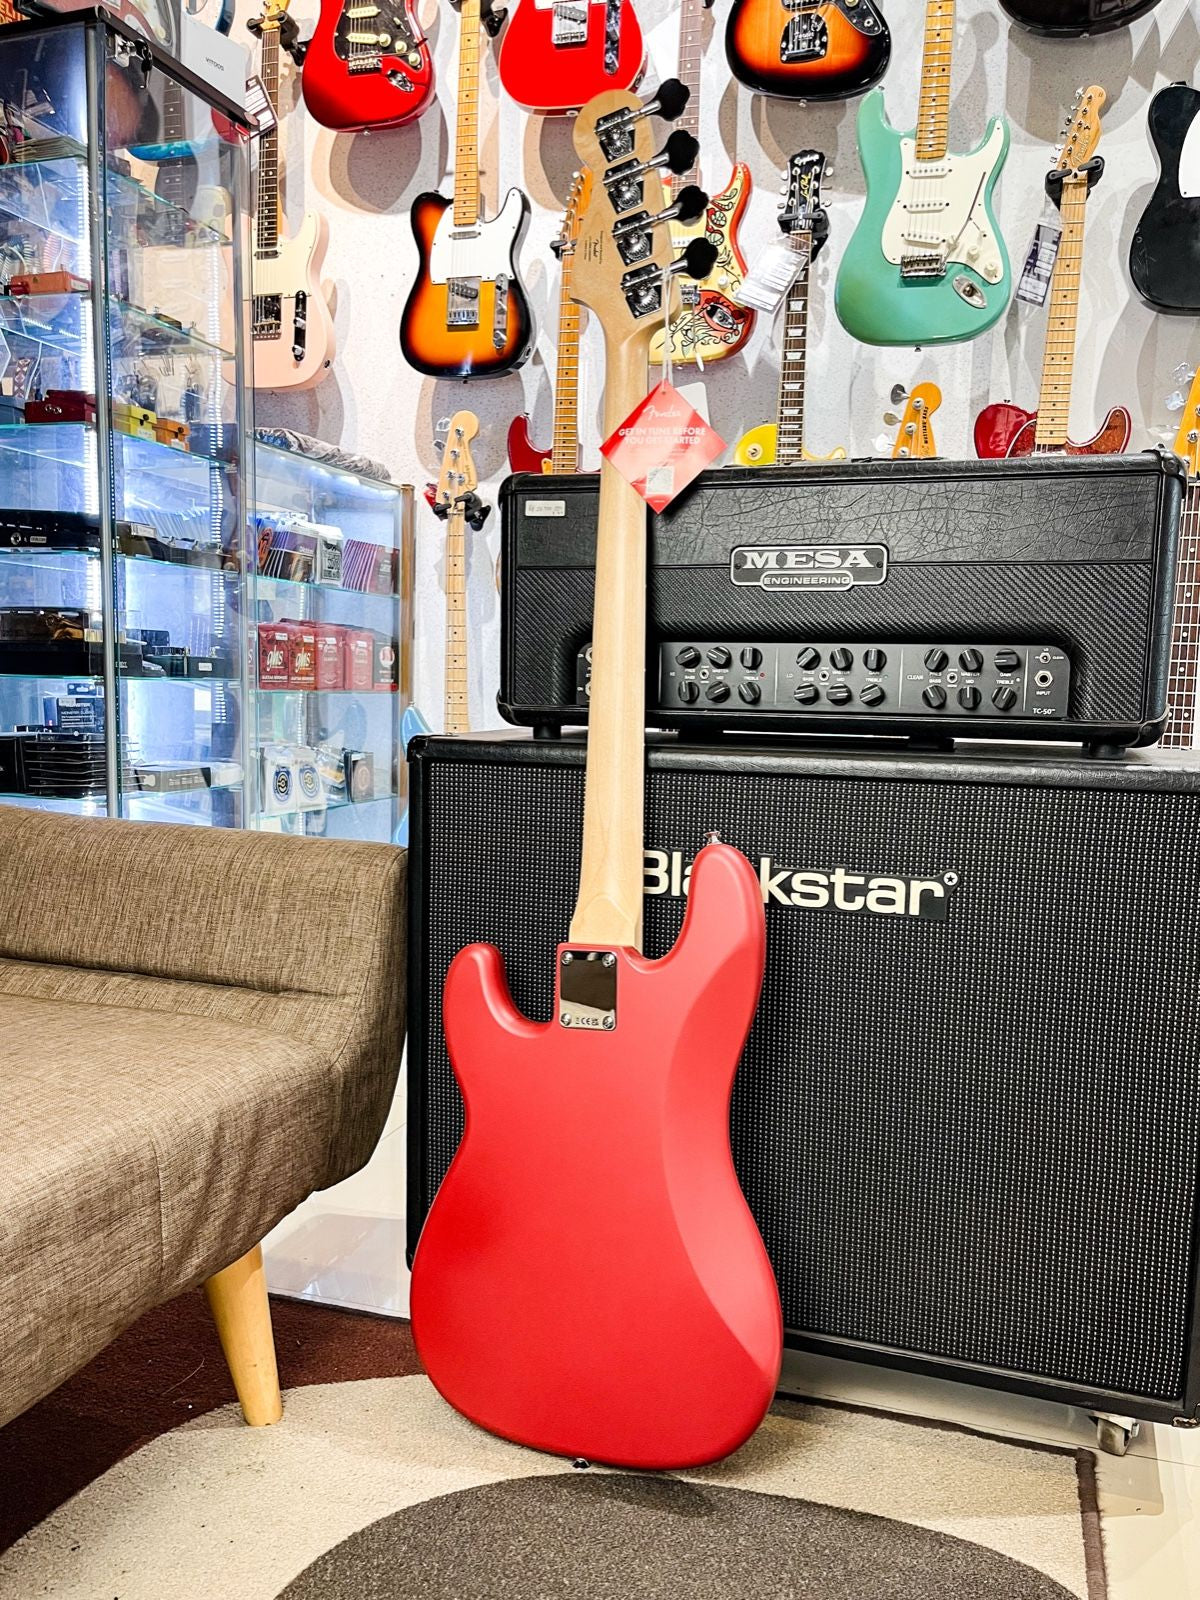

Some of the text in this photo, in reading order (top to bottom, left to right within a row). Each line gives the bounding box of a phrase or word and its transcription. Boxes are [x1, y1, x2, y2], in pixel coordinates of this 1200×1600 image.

[643, 405, 682, 421] Fender
[618, 428, 634, 437] GET
[673, 427, 706, 436] BEFORE
[661, 436, 701, 445] STARTED
[742, 549, 875, 569] MESA
[763, 577, 850, 585] ENGINEERING
[643, 850, 945, 916] Blkstar
